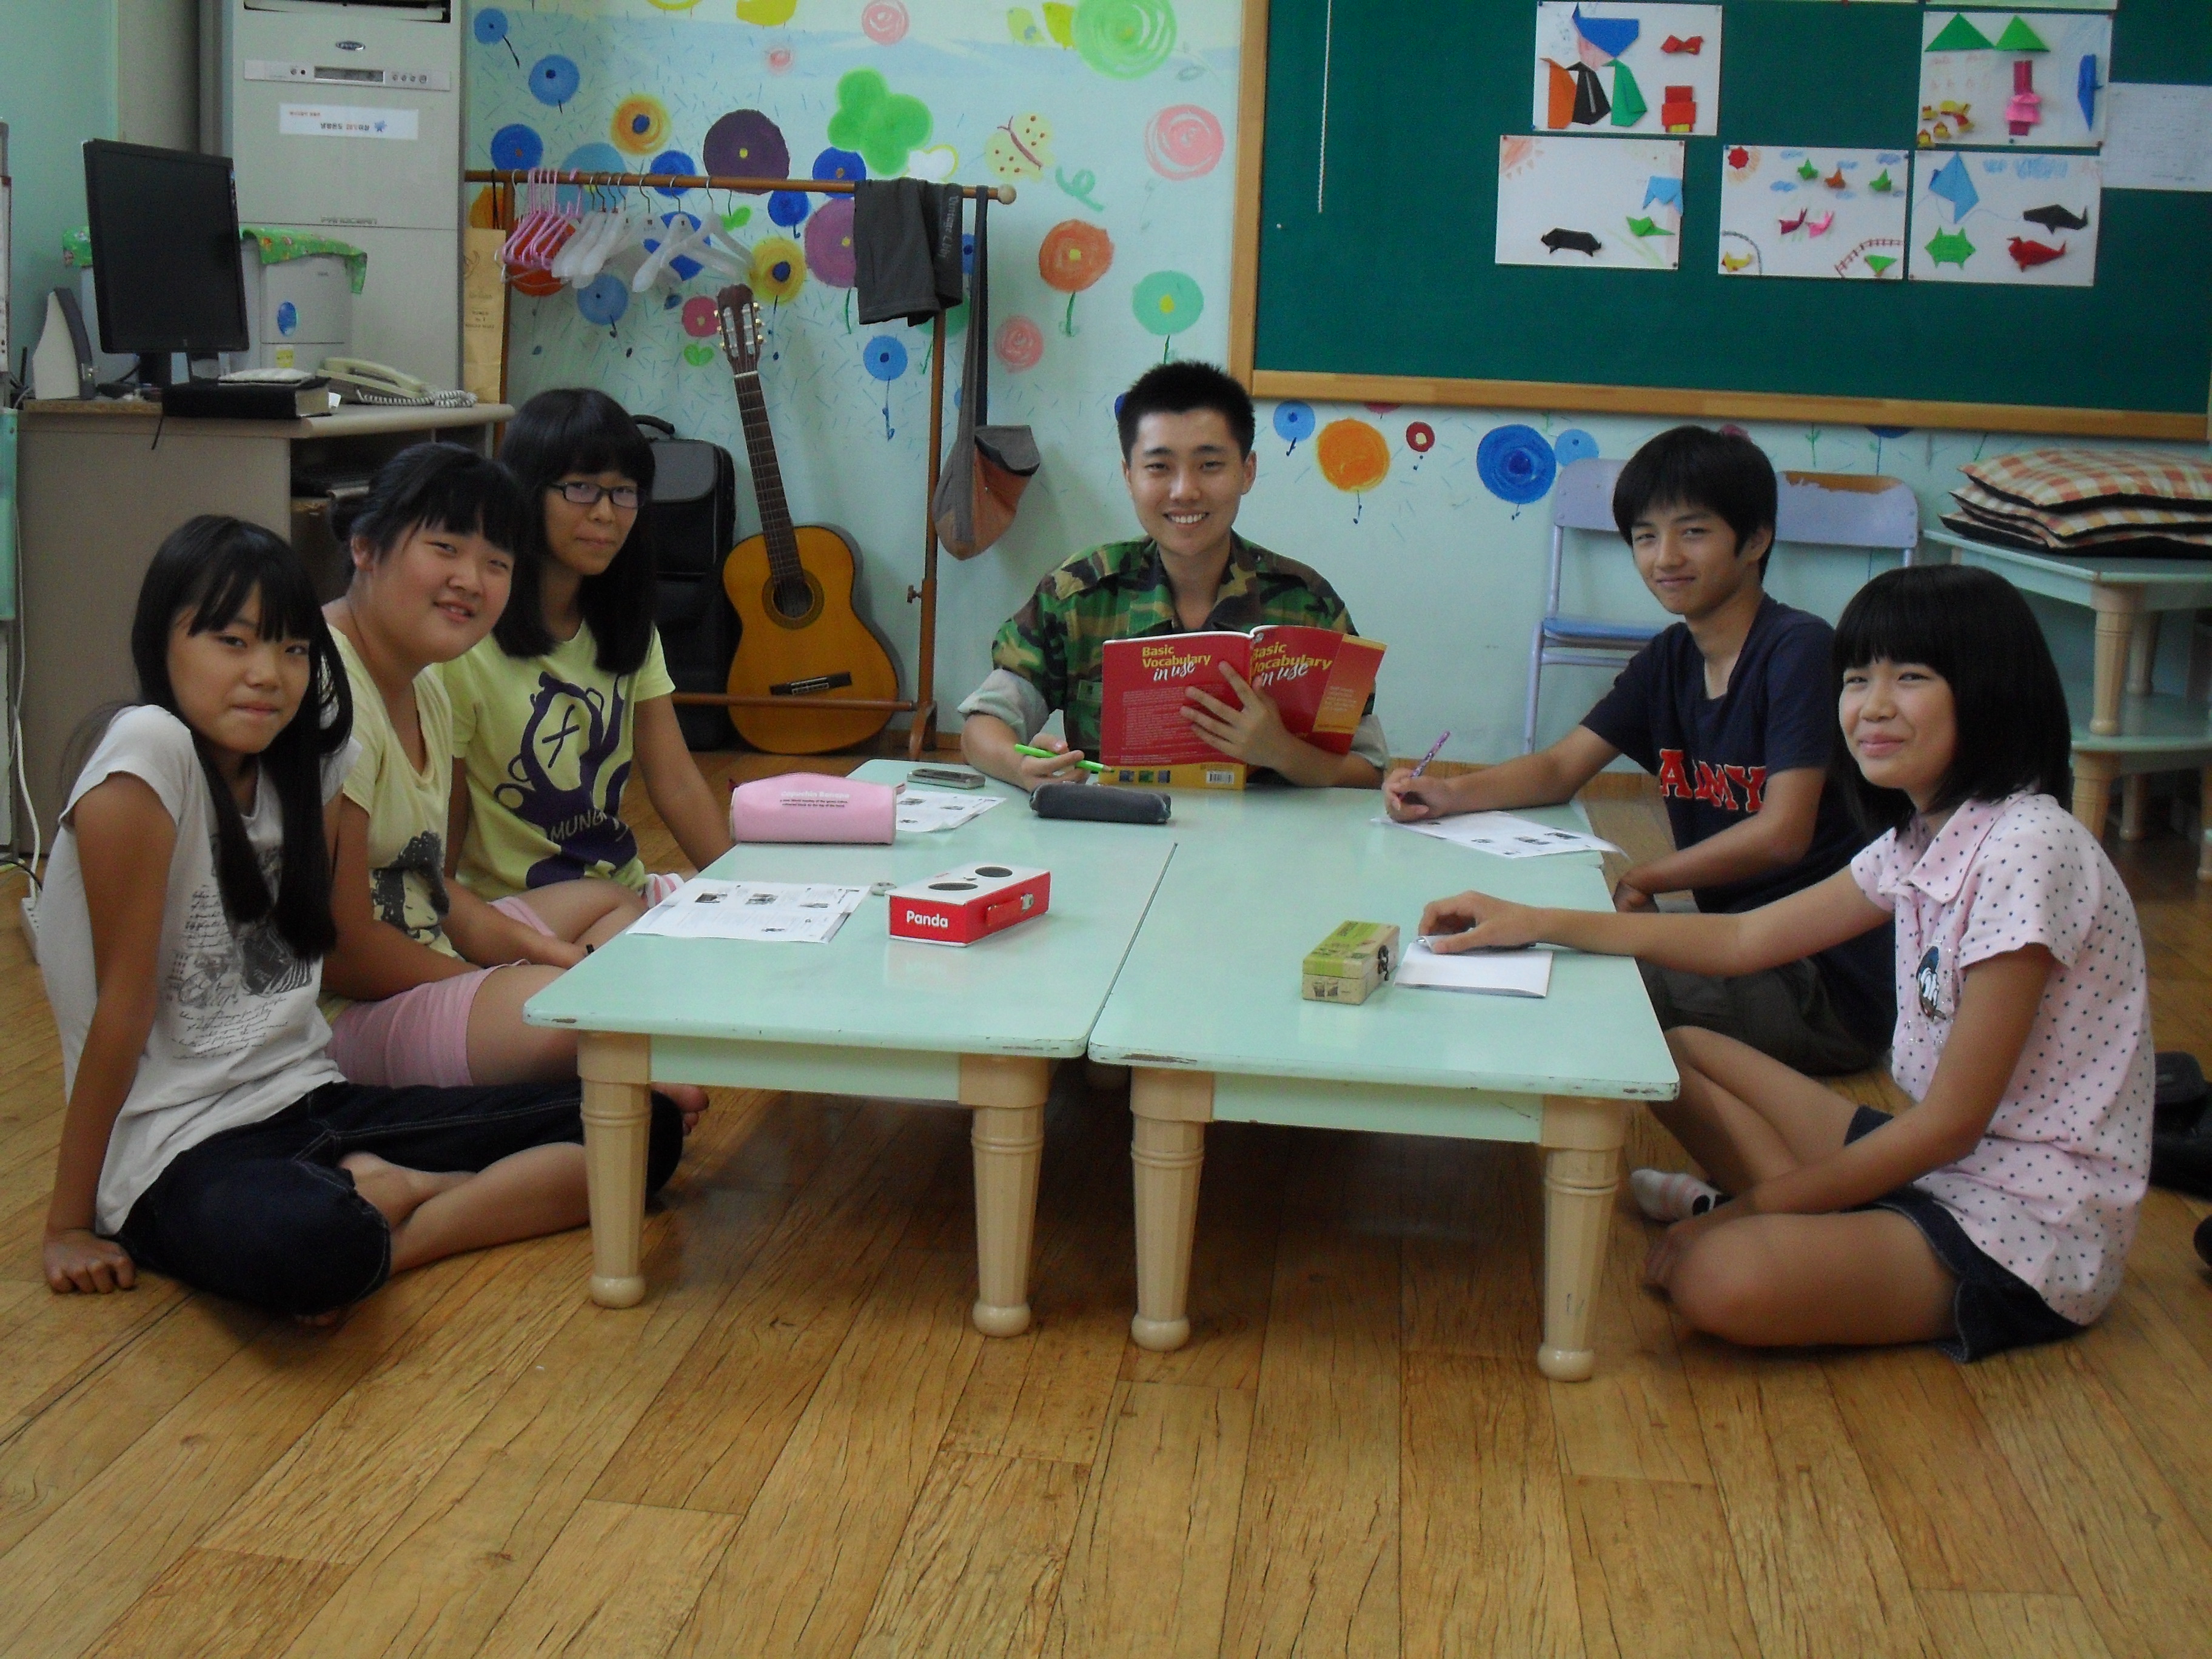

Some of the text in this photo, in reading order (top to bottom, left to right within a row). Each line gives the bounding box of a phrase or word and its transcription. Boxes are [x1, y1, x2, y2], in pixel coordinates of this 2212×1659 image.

[1142, 645, 1175, 657] Basic
[1142, 654, 1212, 668] Vocabulary
[1153, 661, 1195, 681] in use
[1276, 663, 1309, 681] use
[907, 910, 948, 928] Panda
